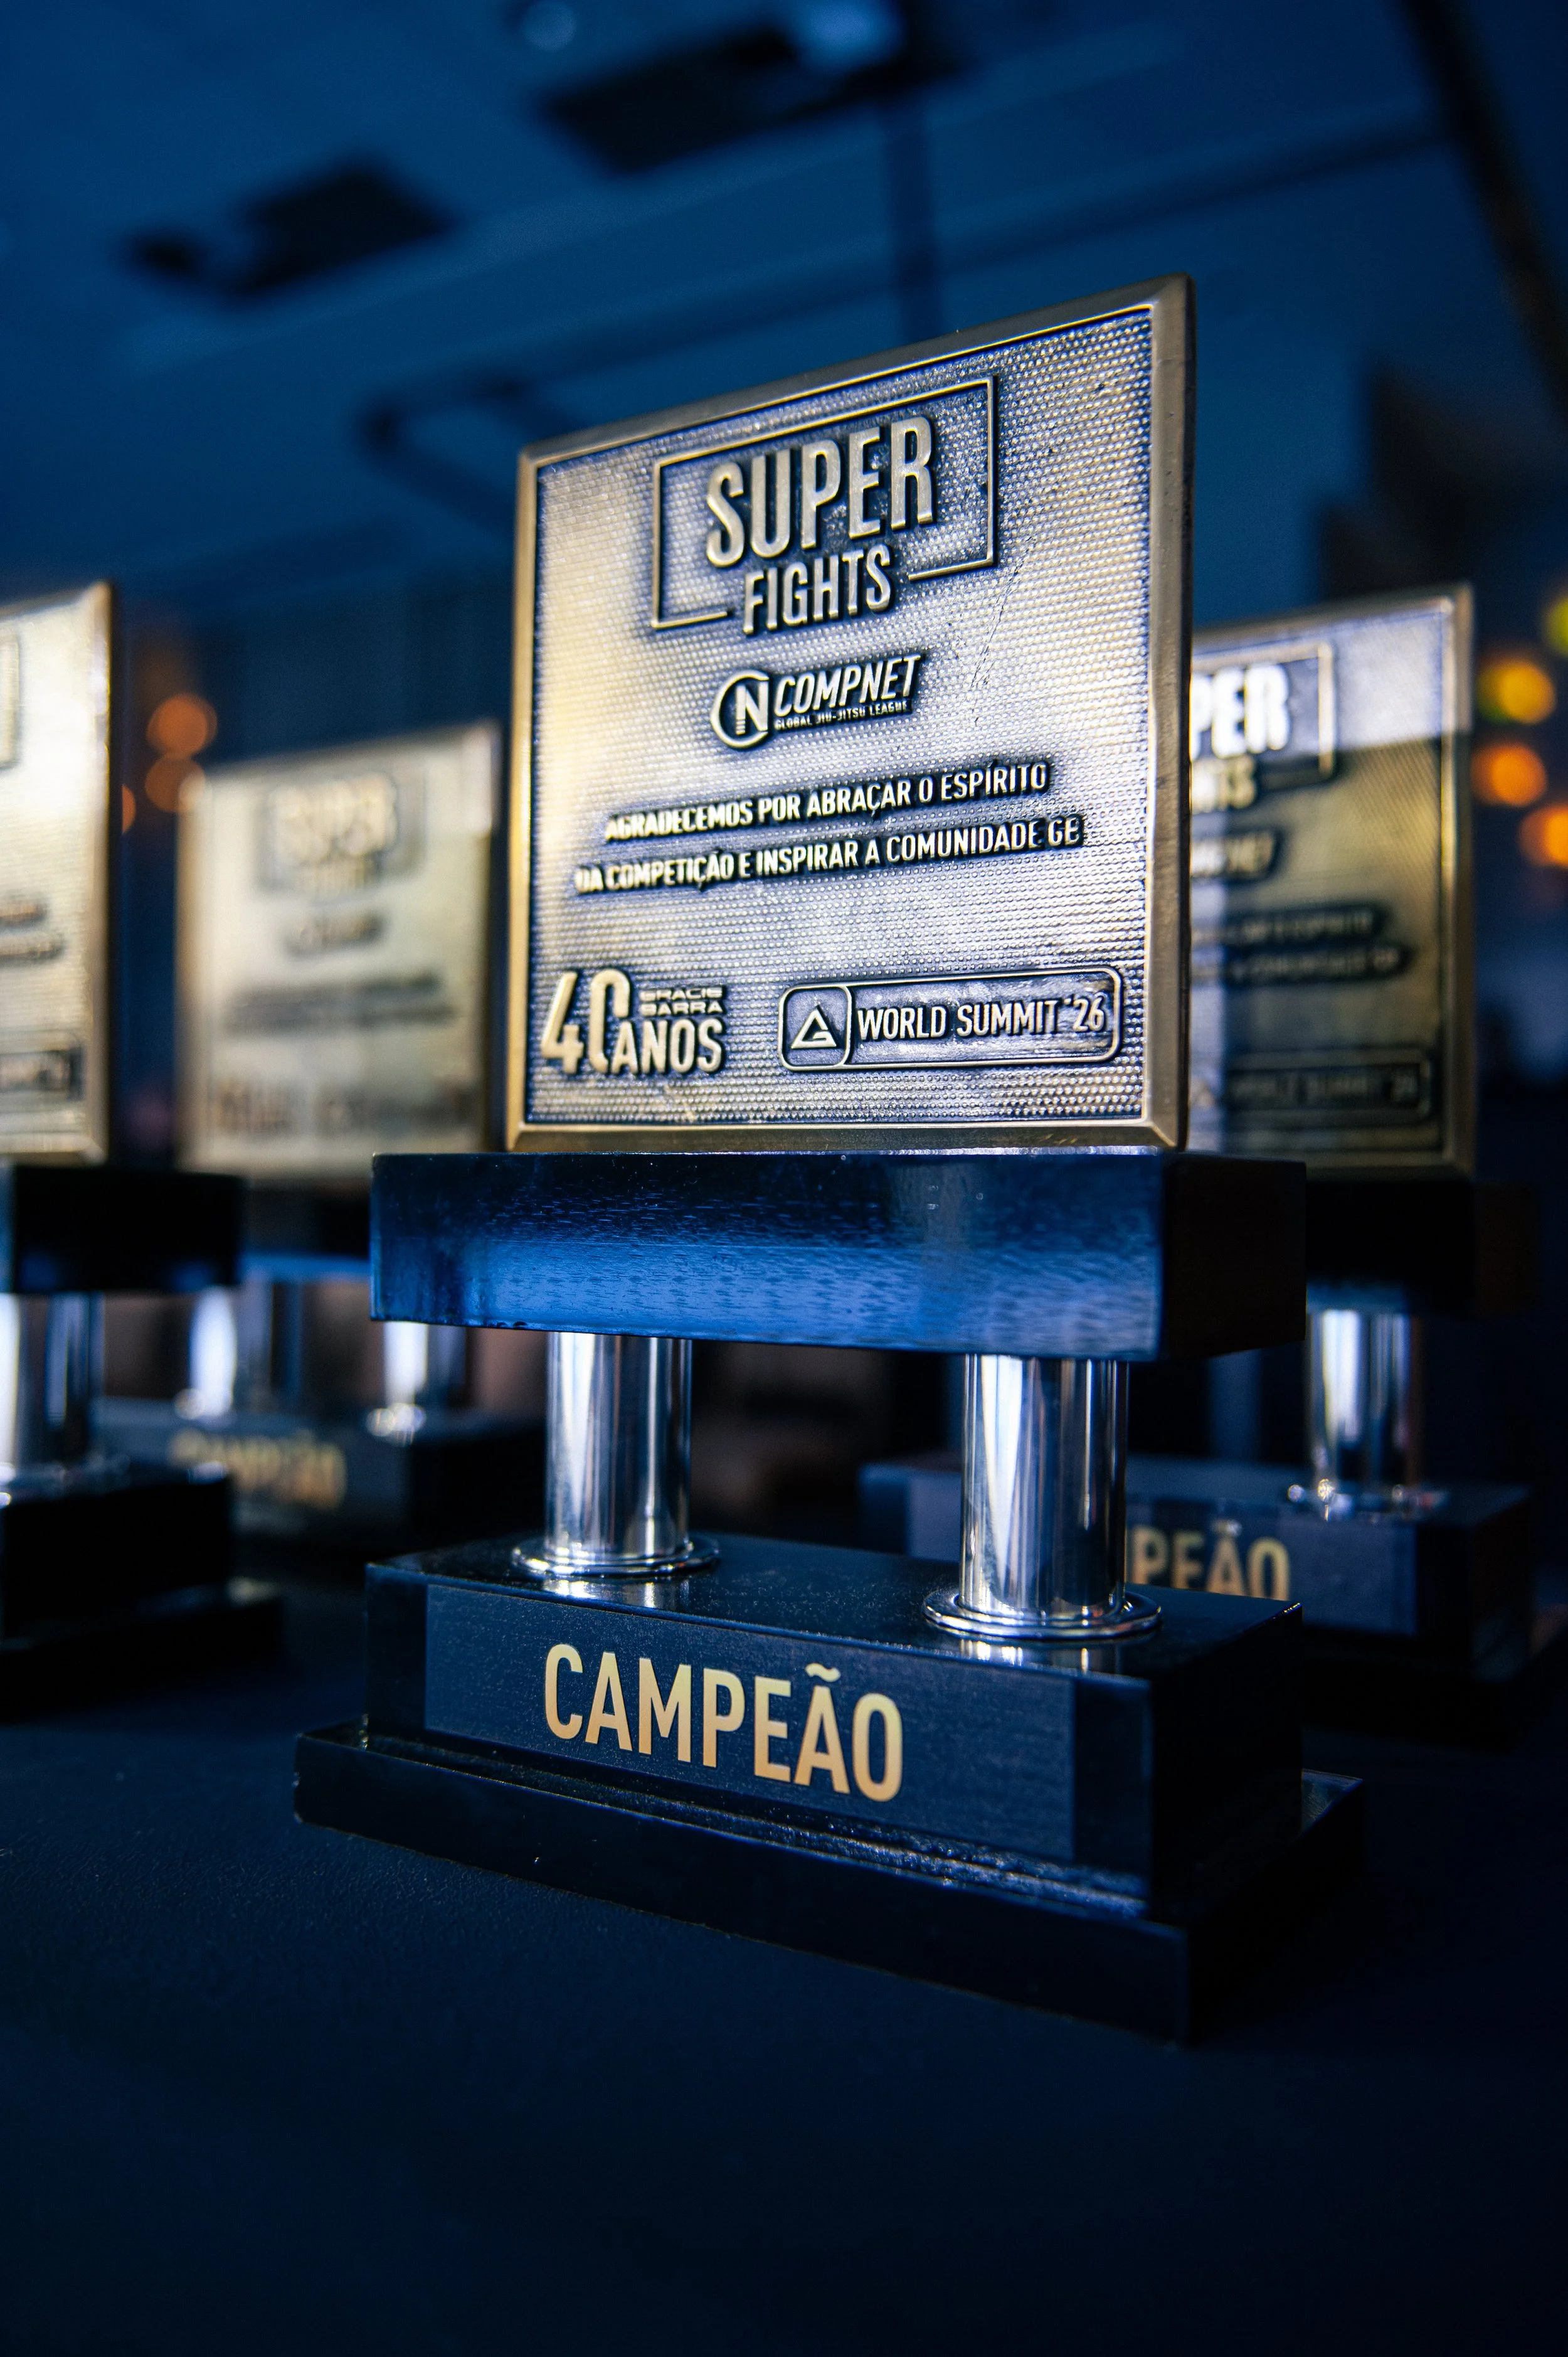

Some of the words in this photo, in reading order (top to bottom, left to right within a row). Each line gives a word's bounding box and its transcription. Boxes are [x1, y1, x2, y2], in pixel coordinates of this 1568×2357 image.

[706, 416, 933, 567] SUPER
[743, 544, 891, 634] FIGHTS
[774, 654, 921, 716] COMPNET
[775, 715, 812, 731] GLOBAL
[816, 707, 866, 725] JIU-JITSU
[869, 700, 908, 716] LEAGUE
[1189, 662, 1289, 762] PER
[605, 799, 753, 841] AGRADECEMOS
[758, 793, 801, 823] POR
[807, 778, 911, 819] ABRAÇAR
[919, 775, 933, 804] O
[941, 760, 1048, 801] ESPÍRITO
[575, 868, 603, 893] DA
[605, 851, 734, 891] COMPETIÇÃO
[738, 852, 751, 878] E
[756, 839, 859, 876] INSPIRAR
[864, 839, 879, 867] A
[886, 819, 1044, 863] COMUNIDADE
[639, 987, 723, 1002] GRACIE
[639, 1001, 723, 1016] BARRA
[857, 1006, 946, 1041] WORLD
[957, 1000, 1060, 1037] SUMMIT
[611, 1018, 723, 1074] ANOS
[1131, 1518, 1291, 1601] PEÃO
[544, 1644, 903, 1802] CAMPEÃO
